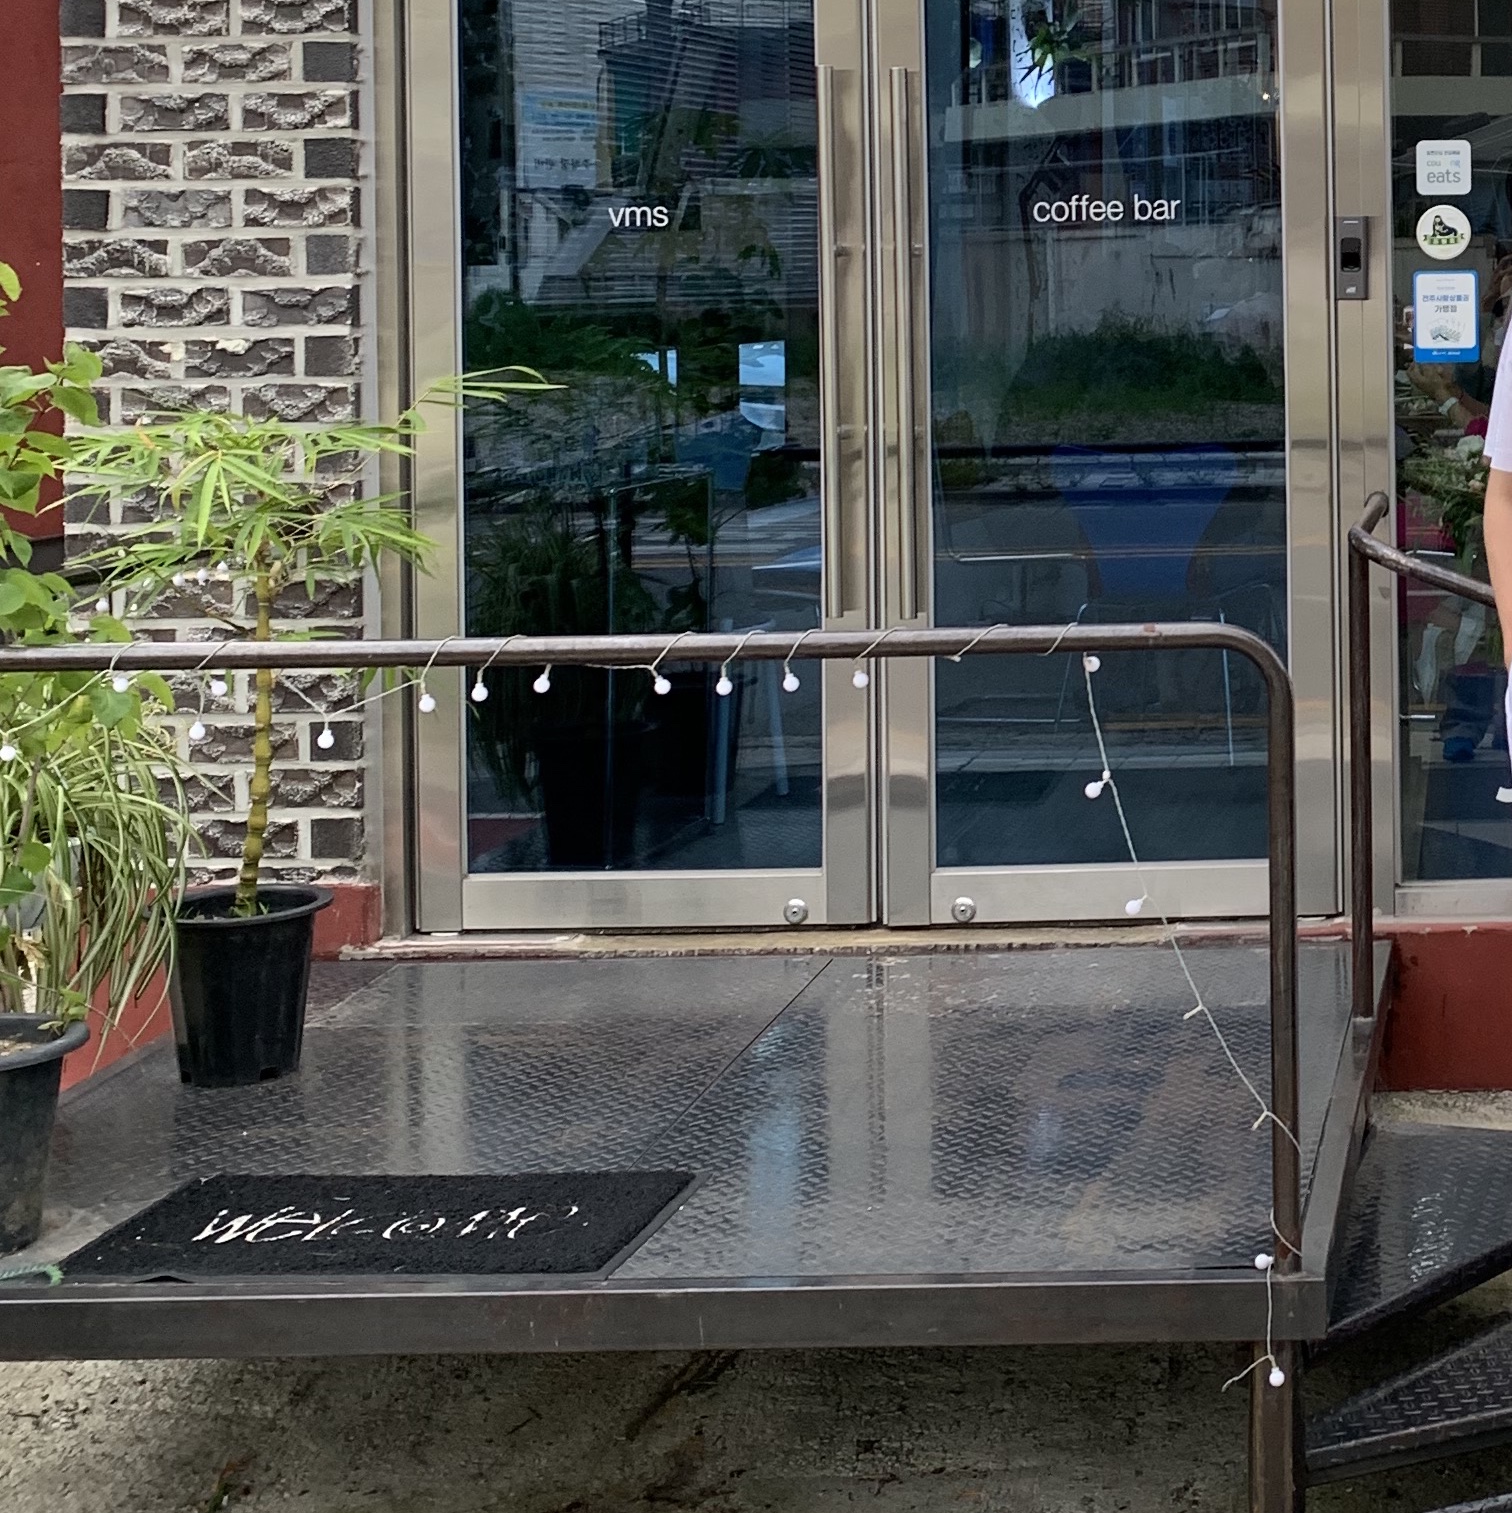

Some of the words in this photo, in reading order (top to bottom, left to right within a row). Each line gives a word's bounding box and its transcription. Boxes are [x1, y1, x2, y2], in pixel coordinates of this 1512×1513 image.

[1426, 169, 1461, 184] eats
[608, 202, 670, 229] vms
[1032, 193, 1125, 224] coffee
[1133, 192, 1183, 223] bar
